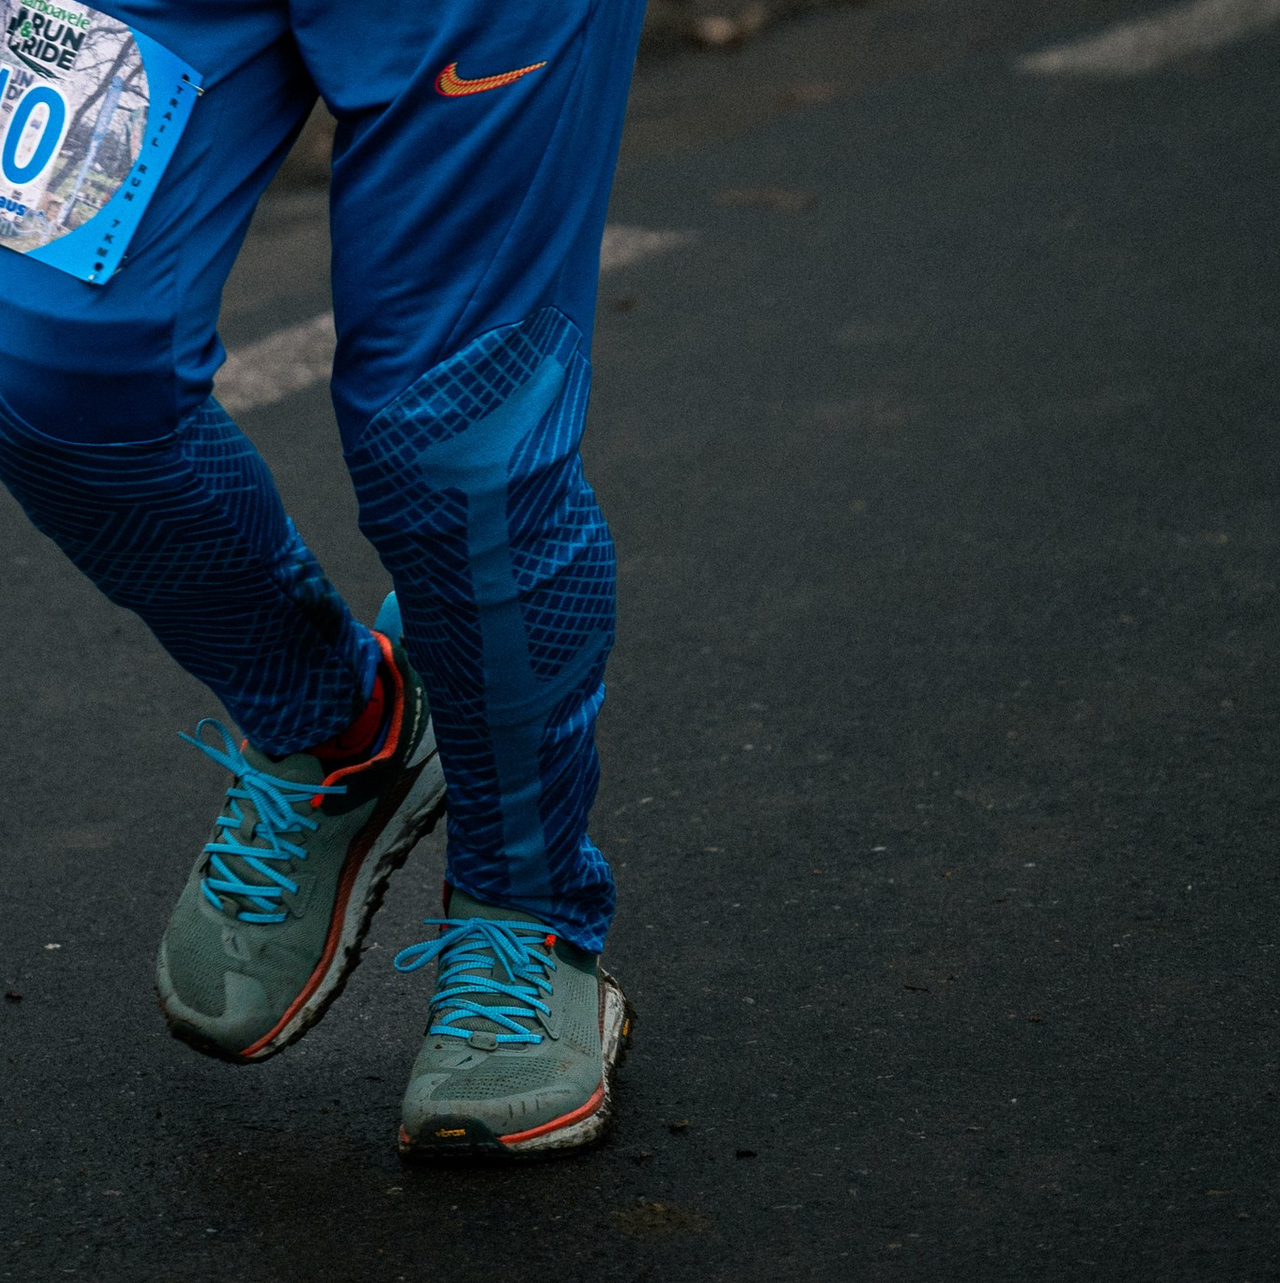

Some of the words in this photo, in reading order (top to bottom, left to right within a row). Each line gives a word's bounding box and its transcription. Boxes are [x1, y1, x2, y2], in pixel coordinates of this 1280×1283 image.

[19, 19, 33, 39] &
[32, 12, 86, 52] RUN
[20, 35, 77, 71] RIDE
[151, 85, 184, 147] TRAIL
[123, 163, 148, 202] RUN
